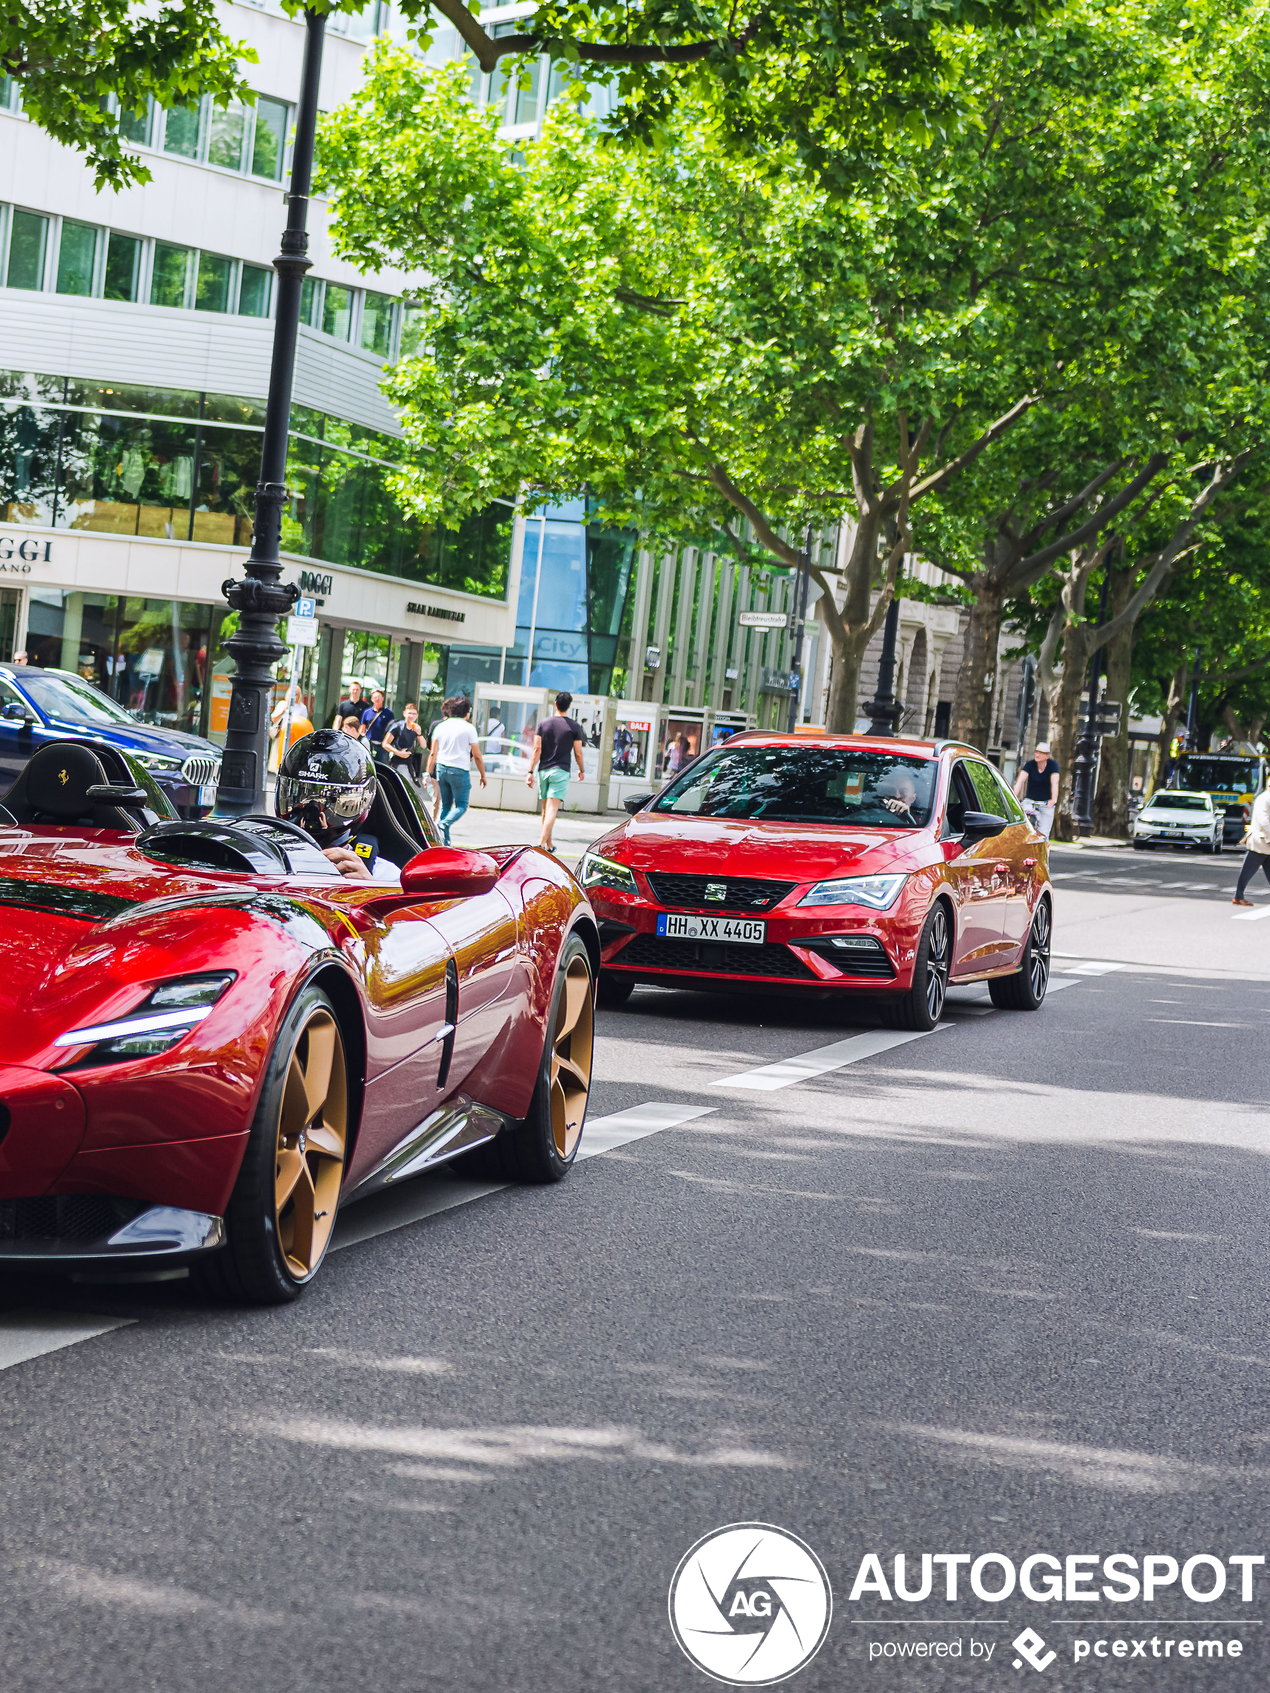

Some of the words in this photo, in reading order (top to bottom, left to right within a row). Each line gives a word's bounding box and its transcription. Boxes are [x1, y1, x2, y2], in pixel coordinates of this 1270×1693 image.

[300, 570, 333, 595] BOGGI
[537, 637, 582, 658] City
[630, 722, 649, 731] SALE
[298, 770, 328, 780] SHARK
[668, 917, 687, 935] HH
[700, 919, 719, 937] XX
[724, 921, 762, 940] 4405
